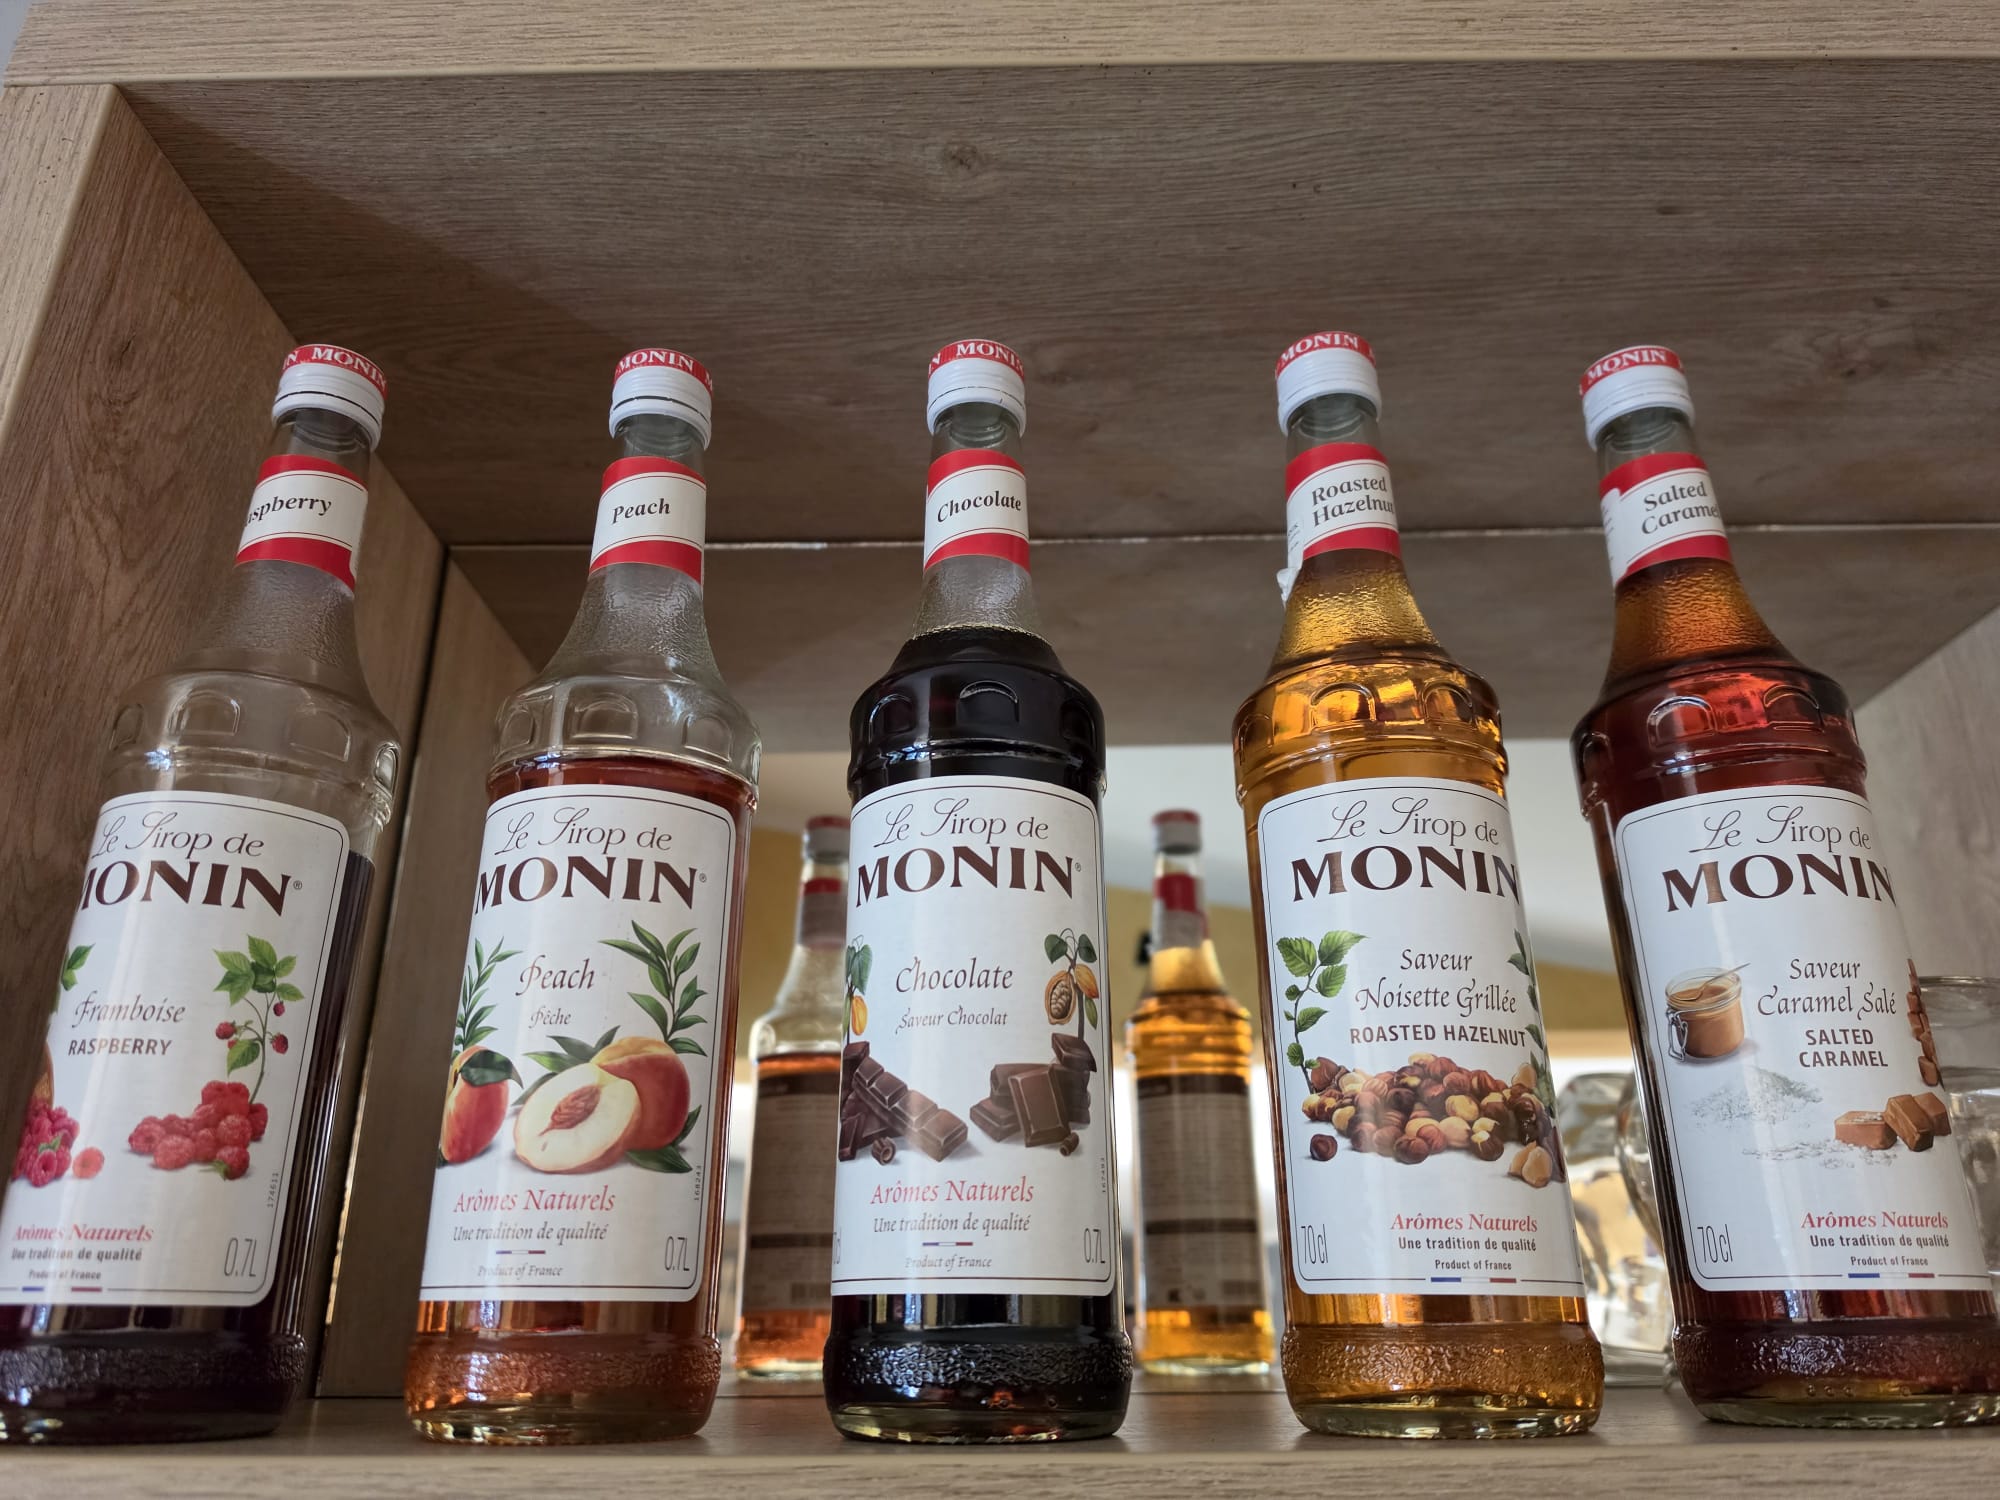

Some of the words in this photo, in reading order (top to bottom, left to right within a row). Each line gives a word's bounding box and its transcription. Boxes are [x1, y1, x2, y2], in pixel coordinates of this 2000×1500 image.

[621, 350, 695, 372] MONIN
[1280, 333, 1358, 366] MONIN
[311, 346, 387, 390] MONIN
[1587, 349, 1667, 382] MONIN
[1312, 476, 1387, 506] Roasted
[1643, 481, 1707, 512] Salted
[611, 498, 671, 525] Peach
[937, 490, 1021, 523] Chocolate
[92, 815, 126, 858] Le
[125, 811, 213, 860] Sirop
[223, 832, 265, 857] de
[494, 812, 535, 856] Le
[537, 807, 626, 854] Sirop
[637, 827, 673, 850] de
[873, 803, 913, 847] Le
[920, 798, 1007, 844] Sirop
[1016, 816, 1049, 840] de
[1316, 800, 1367, 843] Le
[1379, 796, 1467, 847] Sirop
[1475, 821, 1499, 846] de
[1689, 810, 1741, 853] Le
[1756, 805, 1842, 853] Sirop
[1850, 827, 1872, 850] de
[1291, 845, 1520, 905] MONIN
[1662, 853, 1897, 912] MONIN
[895, 956, 1014, 993] Chocolate
[1400, 948, 1473, 972] Saveur
[1789, 958, 1862, 980] Saveur
[515, 954, 596, 996] Peach
[72, 990, 187, 1028] Framboise
[1355, 976, 1450, 1011] Noisette
[1456, 978, 1517, 1018] Grillée
[1757, 985, 1853, 1015] Caramel
[1857, 981, 1897, 1020] Salé
[528, 1005, 572, 1029] Pêche
[895, 1008, 944, 1034] Saveur
[947, 1005, 1008, 1026] Chocolat
[68, 1038, 173, 1056] RASPBERRY
[1350, 1024, 1436, 1044] ROASTED
[1444, 1024, 1526, 1047] HAZELNUT
[1805, 1029, 1873, 1046] SALTED
[1799, 1050, 1889, 1068] CARAMEL
[453, 1188, 518, 1213] Arômes
[522, 1185, 617, 1211] Naturels
[870, 1180, 939, 1205] Arômes
[944, 1176, 1034, 1203] Naturels
[67, 1223, 154, 1242] Naturels
[453, 1226, 472, 1241] Une
[475, 1223, 533, 1240] tradition
[536, 1222, 553, 1240] de
[556, 1223, 609, 1246] qualité
[873, 1217, 896, 1233] Une
[899, 1213, 959, 1232] tradition
[962, 1212, 979, 1231] de
[982, 1214, 1032, 1238] qualité
[1391, 1213, 1463, 1230] Arômes
[1468, 1213, 1538, 1233] Naturels
[1801, 1211, 1876, 1228] Arômes
[1882, 1211, 1948, 1229] Naturels
[77, 1247, 93, 1261] de
[96, 1247, 143, 1264] qualité
[664, 1236, 690, 1272] 0.7L
[1084, 1228, 1105, 1264] 0.7L
[1300, 1223, 1329, 1265] 70cl
[1398, 1237, 1421, 1251] Une
[1426, 1237, 1480, 1250] tradition
[1484, 1237, 1498, 1250] de
[1501, 1238, 1537, 1253] qualité
[1697, 1223, 1733, 1264] 70cl
[1810, 1235, 1834, 1247] Une
[1840, 1234, 1895, 1247] tradition
[1900, 1234, 1912, 1247] de
[1916, 1234, 1949, 1249] qualité
[223, 1237, 257, 1278] 0.7L
[528, 1265, 563, 1277] France
[945, 1254, 956, 1272] of
[958, 1256, 992, 1268] France
[1435, 1259, 1471, 1270] Product
[1473, 1259, 1482, 1270] of
[1485, 1260, 1512, 1271] France
[1850, 1256, 1887, 1267] Product
[1890, 1256, 1899, 1266] of
[1901, 1256, 1928, 1266] France
[70, 1270, 102, 1281] France
